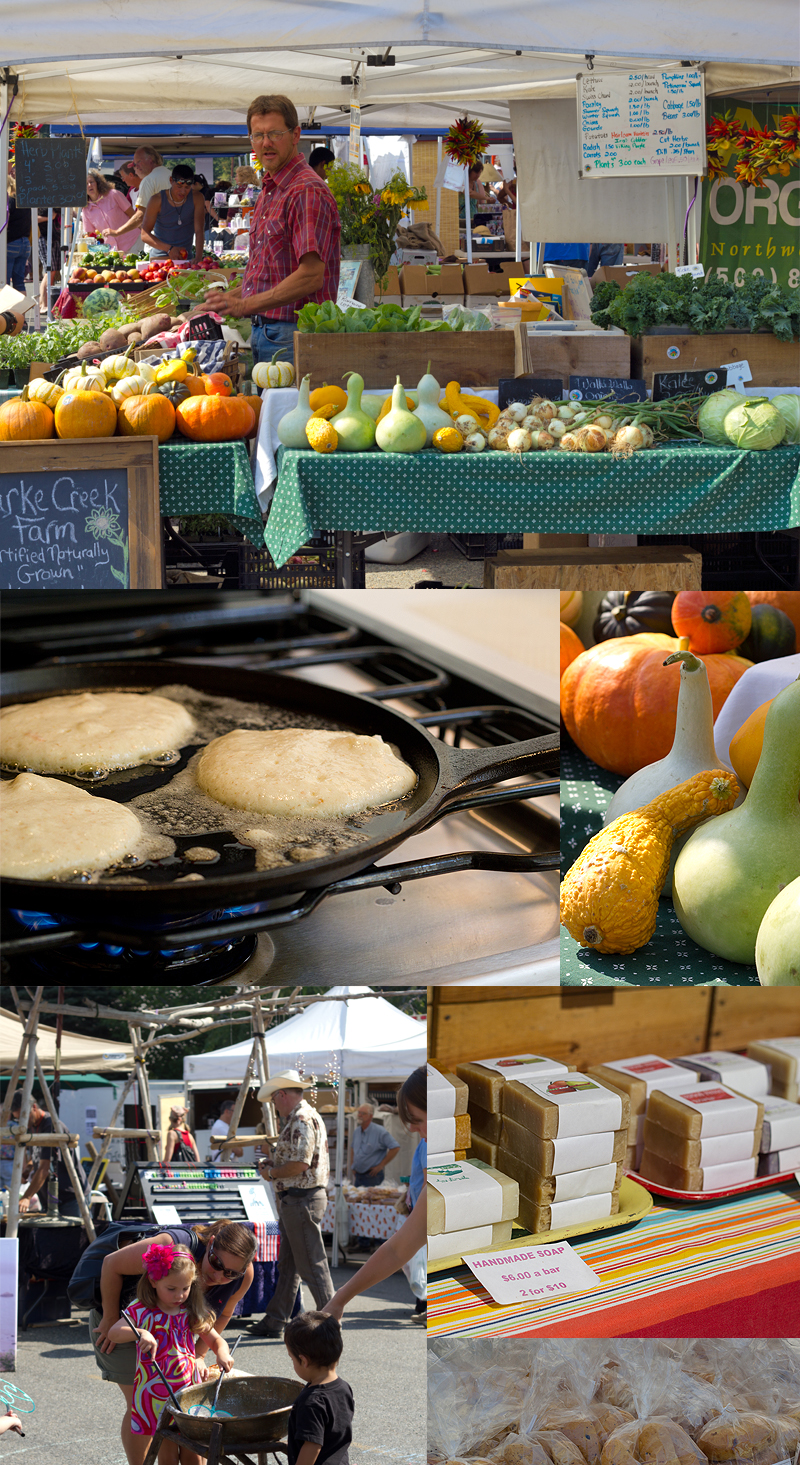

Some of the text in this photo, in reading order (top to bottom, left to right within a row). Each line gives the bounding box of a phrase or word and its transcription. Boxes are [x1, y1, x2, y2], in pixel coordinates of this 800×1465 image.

[663, 99, 684, 112] Cabbage
[18, 192, 56, 206] Planter
[711, 237, 800, 259] Northw
[52, 477, 120, 513] Creek
[12, 514, 78, 545] Farm
[47, 541, 110, 568] Naturally
[472, 1246, 565, 1269] HANDMADE SOAP
[501, 1271, 532, 1282] $6.00
[542, 1266, 560, 1276] bar
[519, 1281, 567, 1297] 2 for $10
